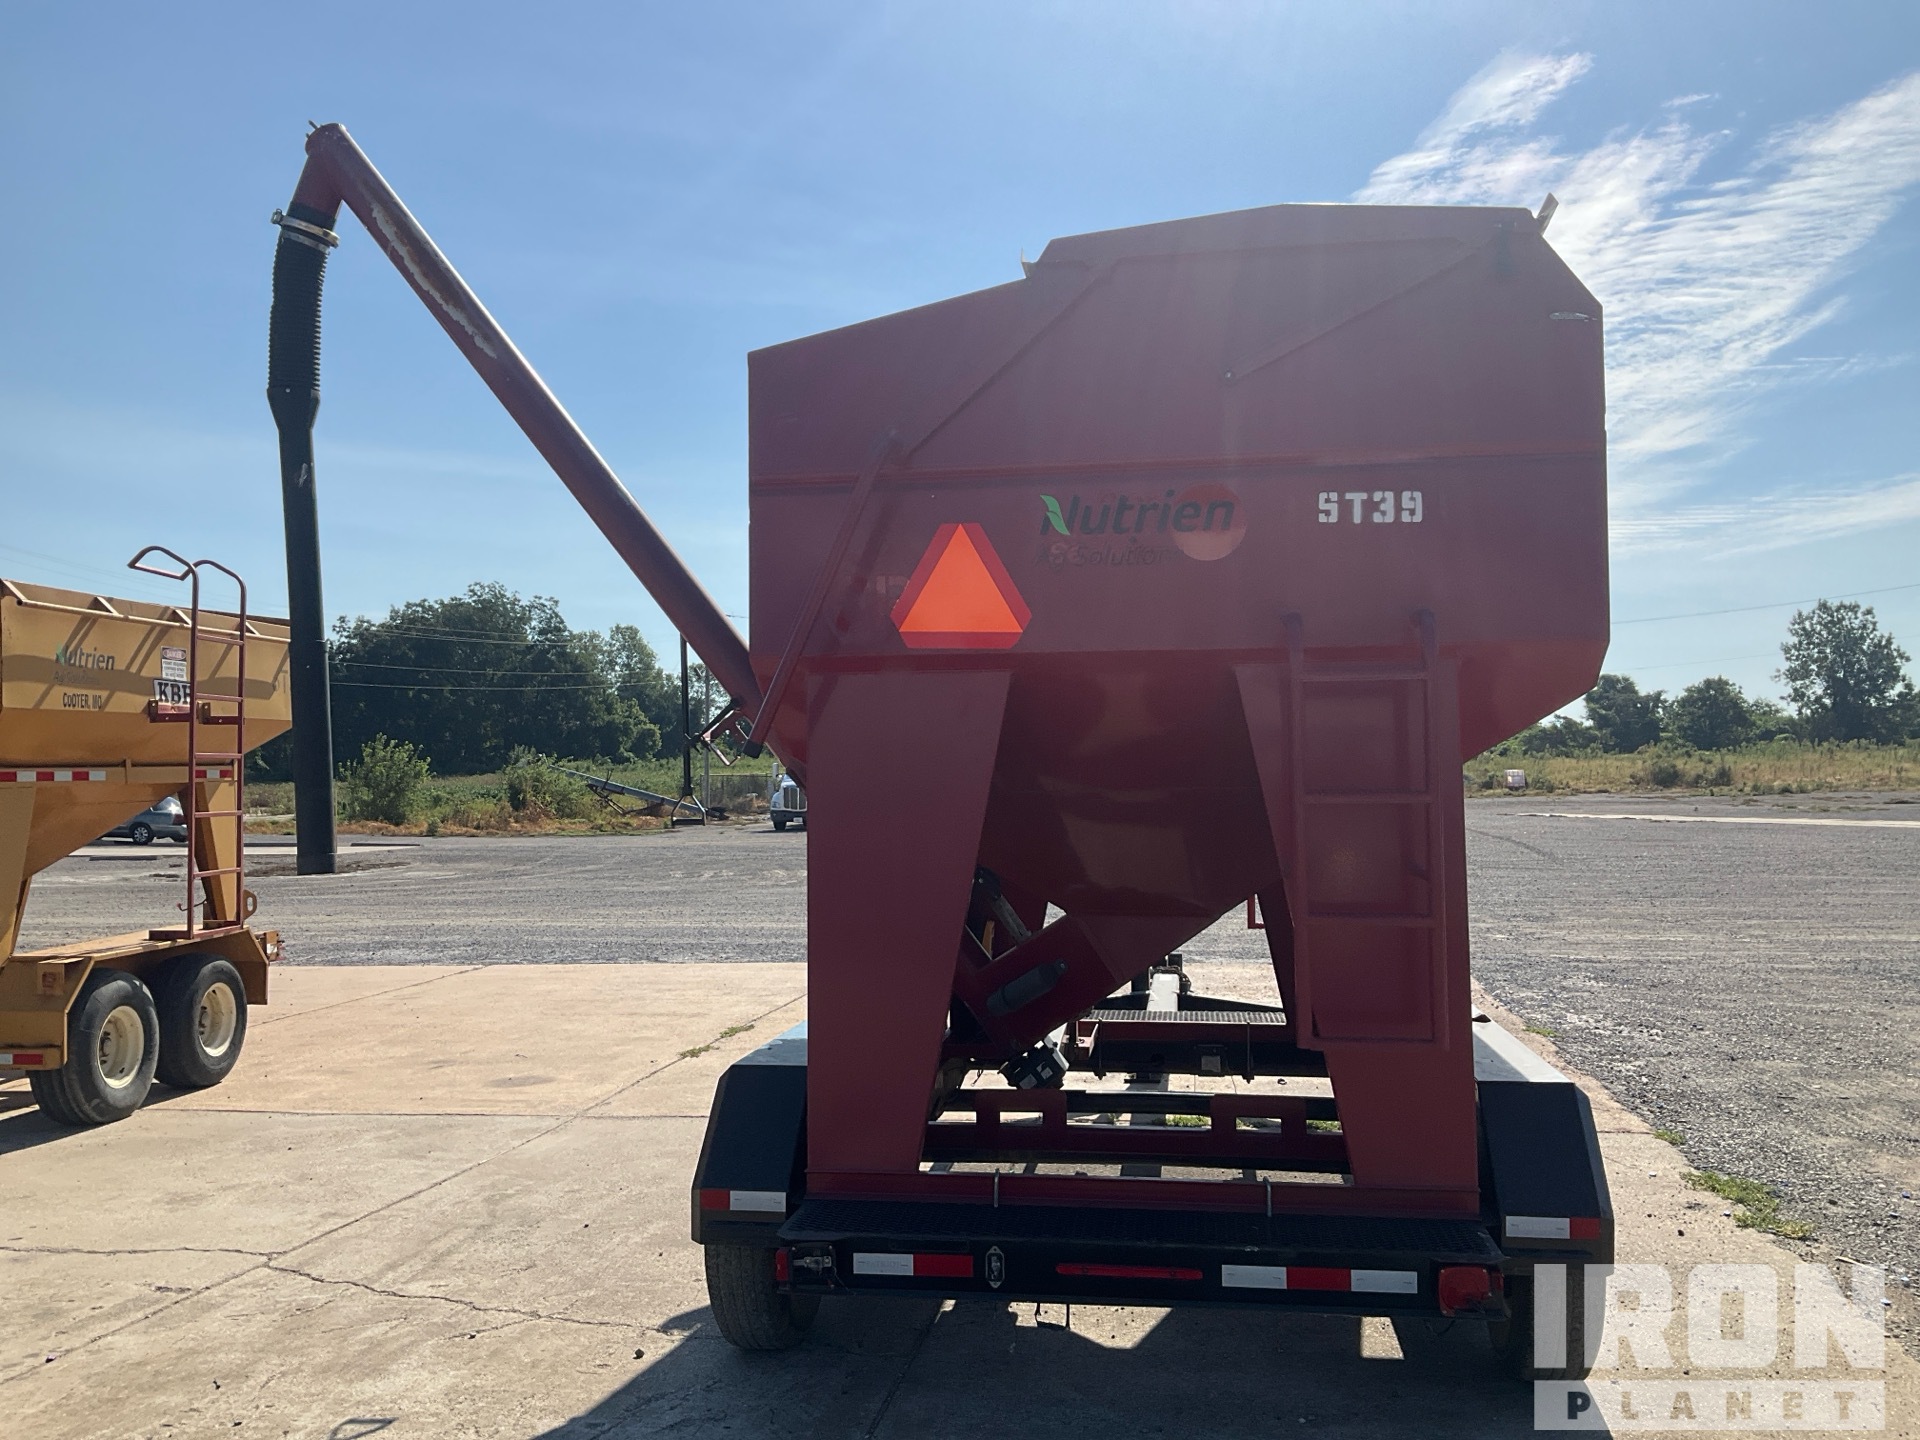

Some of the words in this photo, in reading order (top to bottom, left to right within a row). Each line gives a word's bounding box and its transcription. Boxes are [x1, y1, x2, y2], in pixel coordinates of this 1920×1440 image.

[1040, 489, 1236, 536] Nutrien
[1318, 490, 1423, 524] ST39
[55, 642, 116, 671] Nutrien
